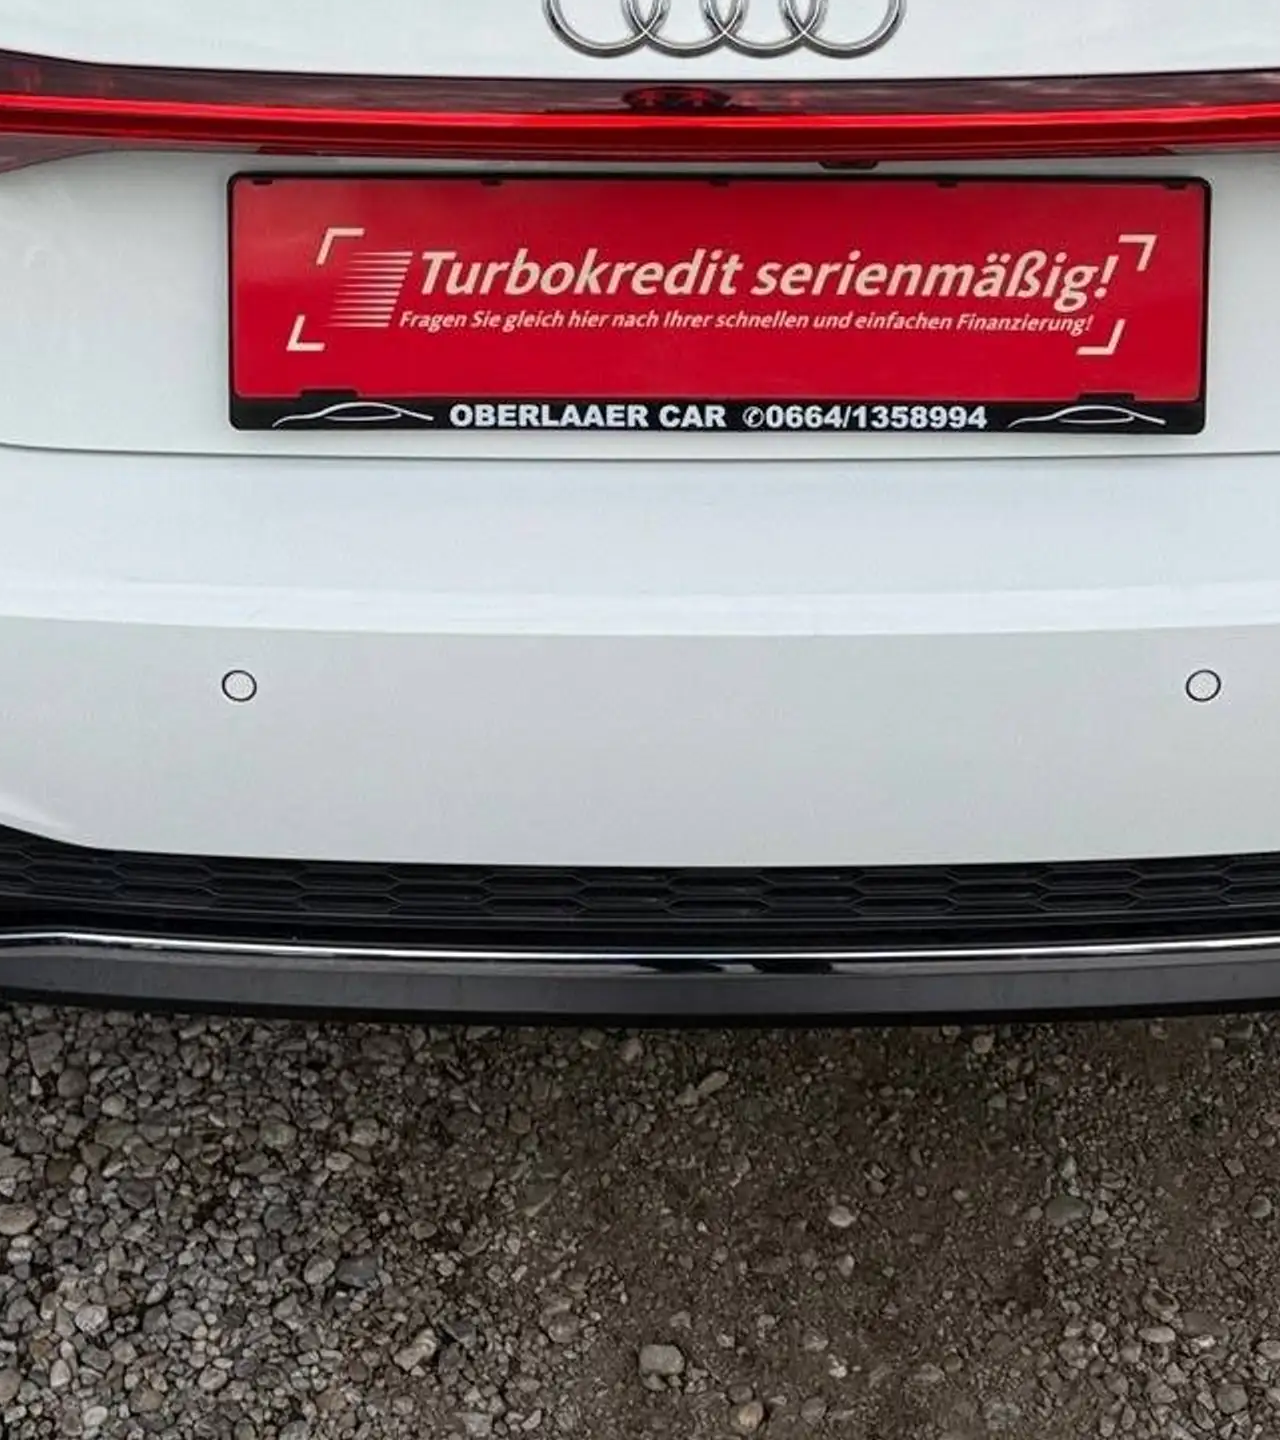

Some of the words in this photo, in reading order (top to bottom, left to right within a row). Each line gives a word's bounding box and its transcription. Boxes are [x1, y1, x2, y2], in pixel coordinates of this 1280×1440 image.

[421, 248, 743, 296] Turbokredit
[750, 250, 1119, 313] serienmäßig!
[399, 310, 467, 333] Fragen
[470, 310, 501, 328] Sie
[503, 310, 565, 333] gleich
[569, 310, 608, 328] hier
[610, 310, 659, 328] nach
[663, 311, 713, 328] Ihrer
[715, 311, 810, 329] schnellen
[812, 312, 849, 330] und
[854, 312, 952, 331] einfachen
[956, 313, 1094, 336] Finanzierung!
[449, 403, 649, 428] OBERLAAER
[658, 404, 727, 428] CAR
